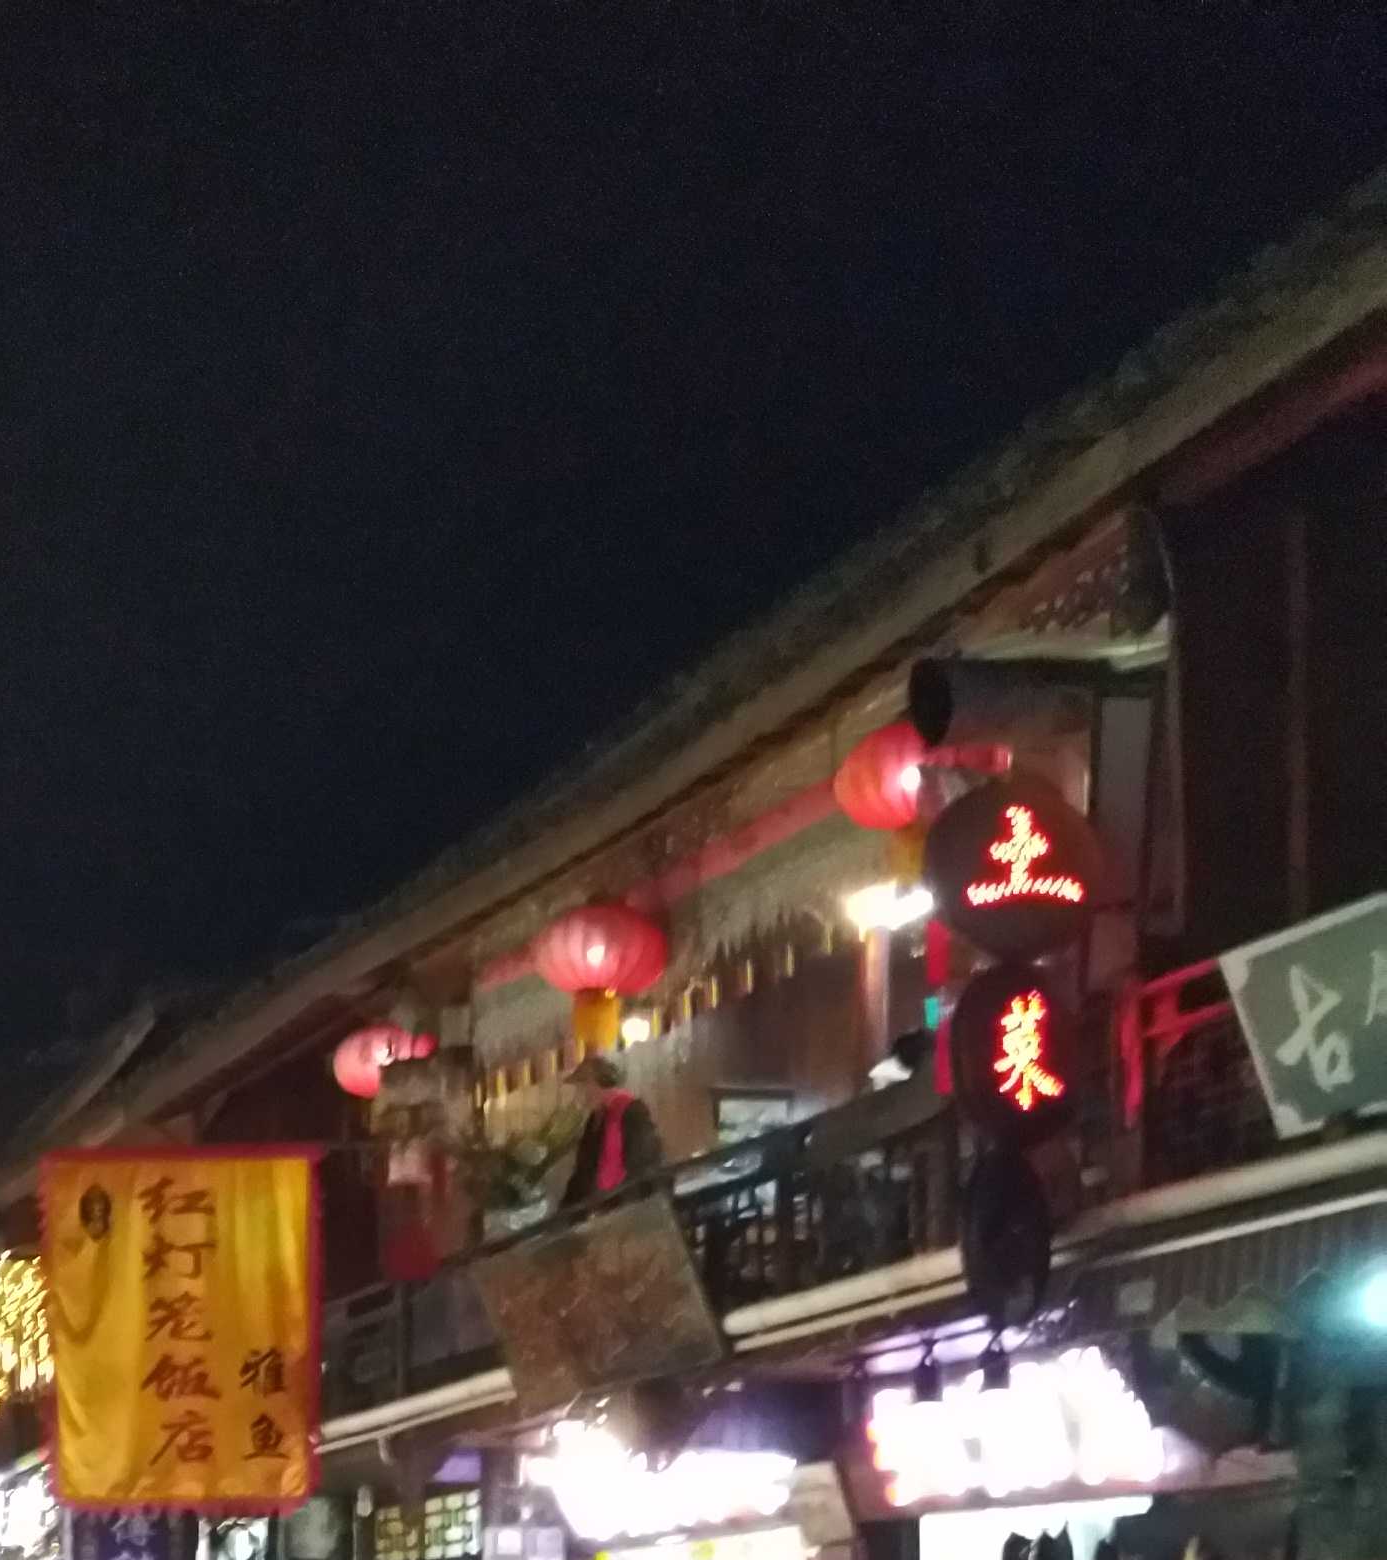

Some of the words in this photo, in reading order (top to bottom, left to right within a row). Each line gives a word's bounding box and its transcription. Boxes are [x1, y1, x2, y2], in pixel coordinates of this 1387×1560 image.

[138, 1176, 221, 1468] 红灯笼饭店
[238, 1346, 291, 1461] 雅鱼
